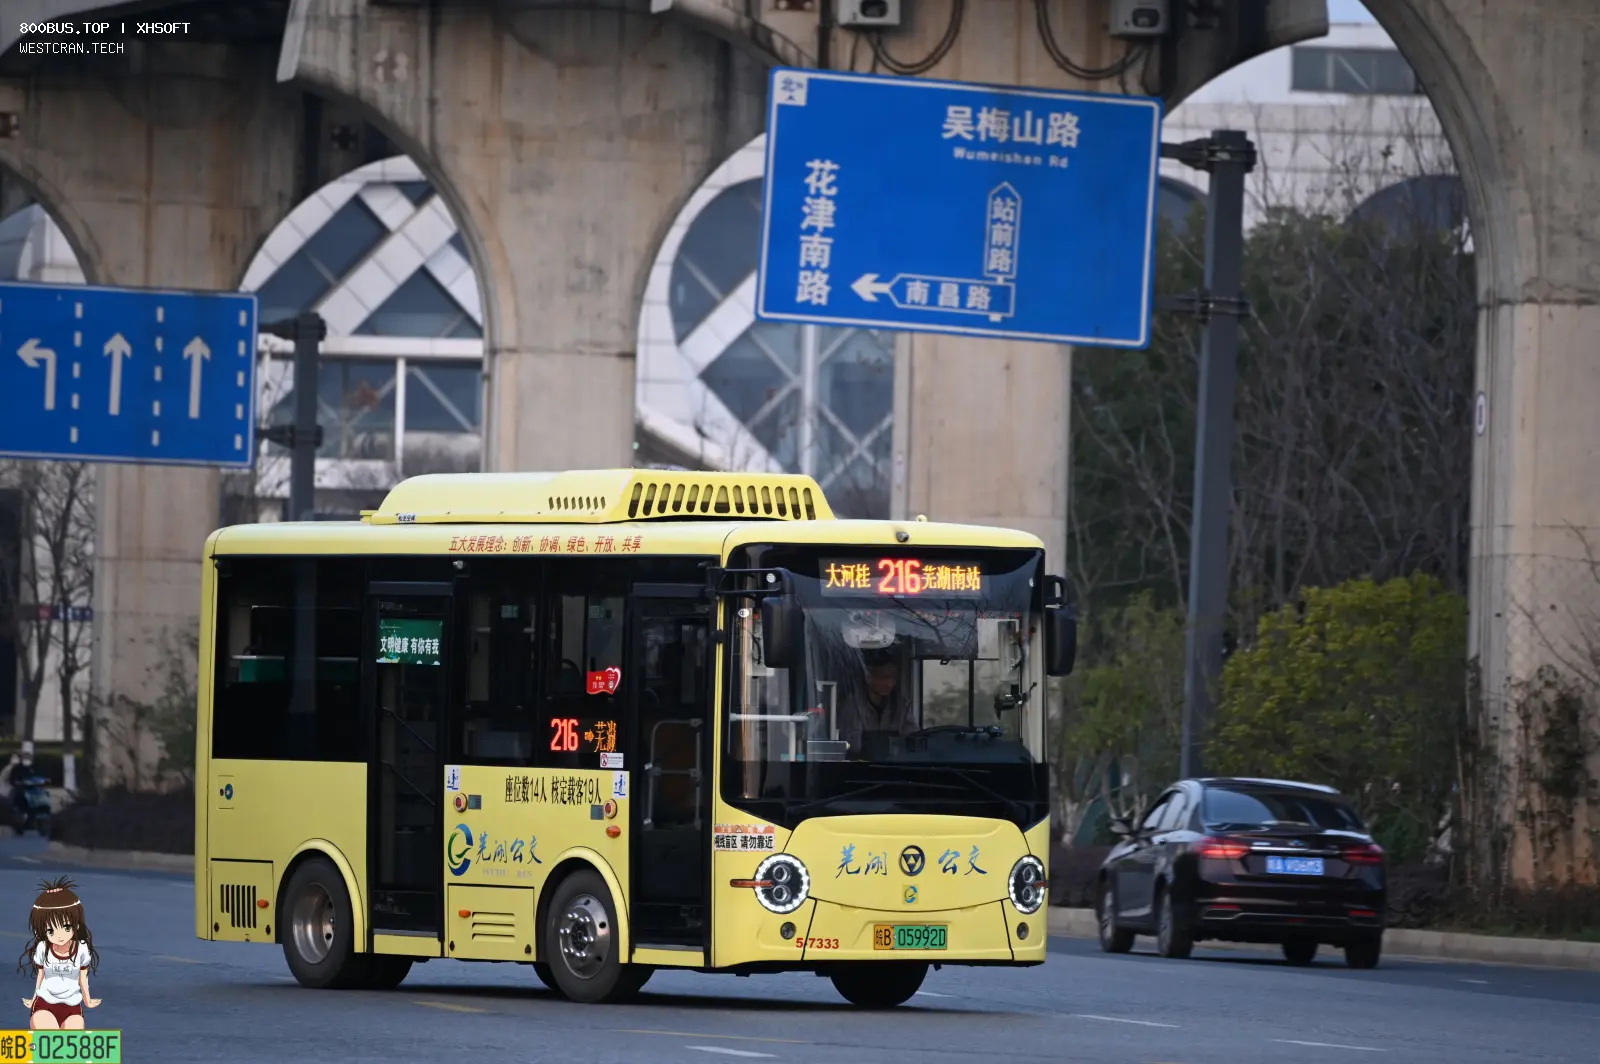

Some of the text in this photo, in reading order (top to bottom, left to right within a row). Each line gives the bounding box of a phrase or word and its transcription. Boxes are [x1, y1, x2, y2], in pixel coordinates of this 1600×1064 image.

[941, 105, 1081, 148] 吴梅山路
[953, 146, 1069, 168] Wumeishan Rd
[796, 159, 840, 306] 花津南路
[987, 197, 1016, 273] 站前路
[905, 280, 992, 310] 南昌路
[878, 558, 922, 593] 216
[921, 564, 981, 591] 芜湖南站
[380, 636, 440, 655] 文明健康 有你有我
[550, 718, 579, 752] 216
[505, 775, 602, 806] 座位数14人 核定载客19人
[740, 834, 773, 850] 请勿靠近
